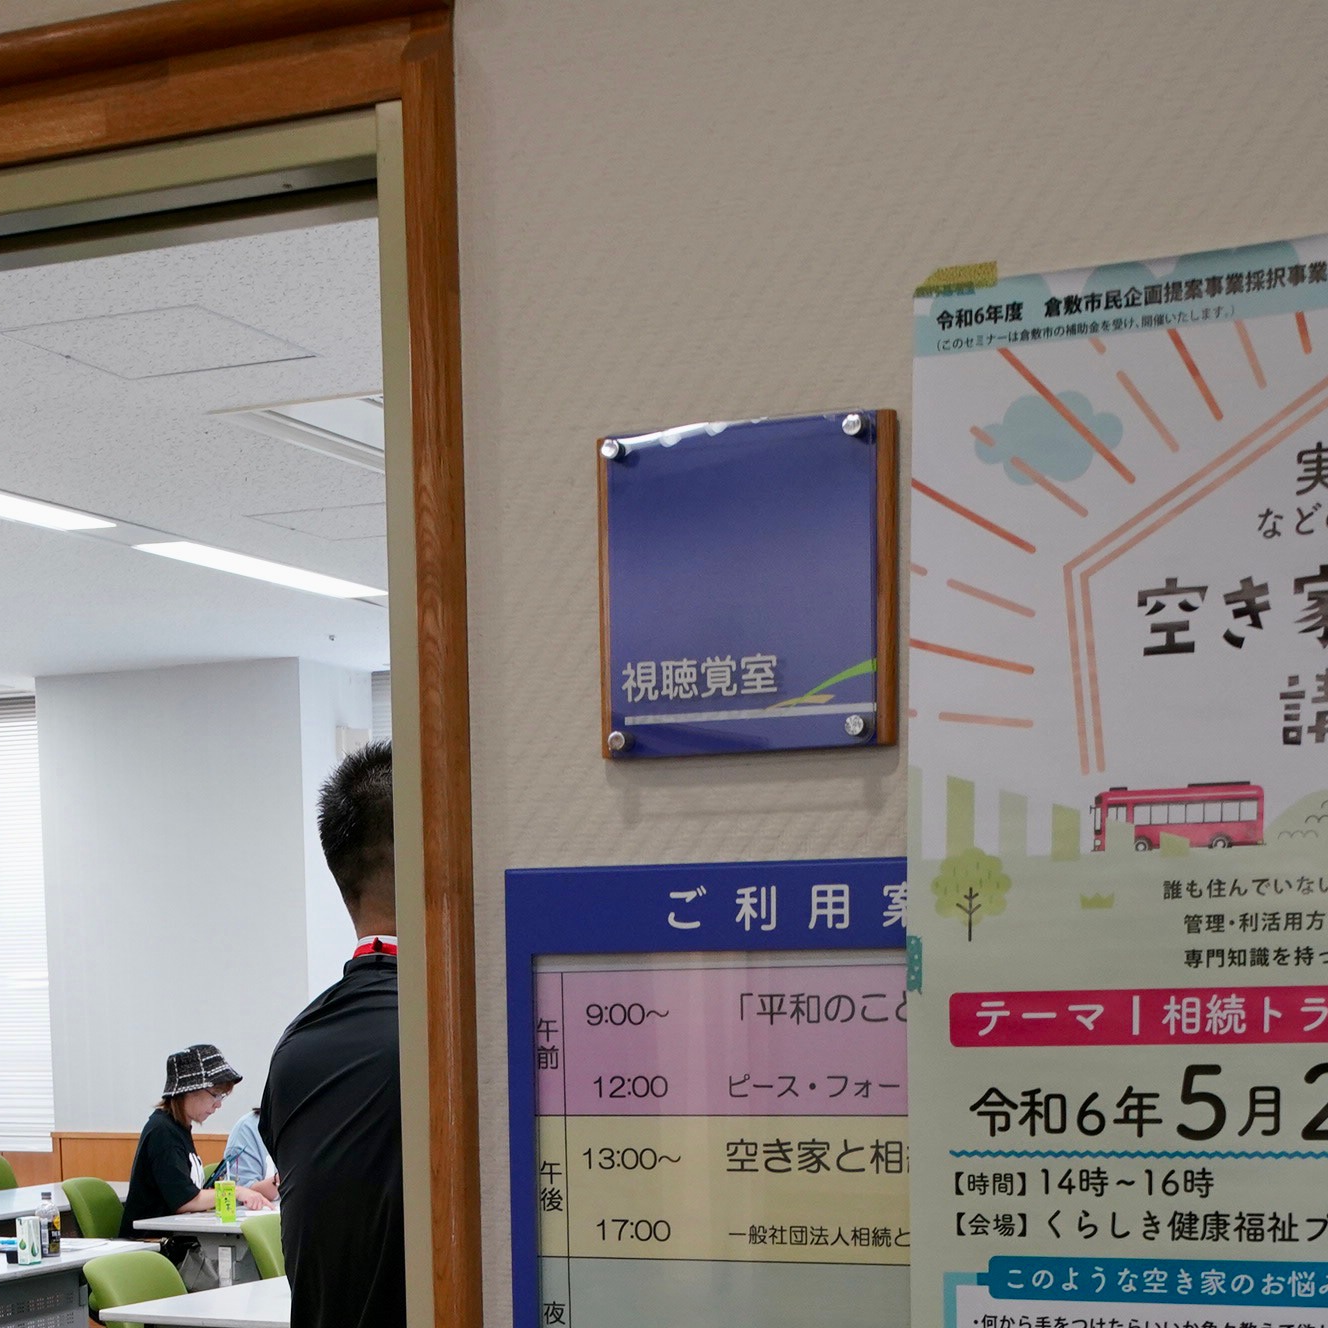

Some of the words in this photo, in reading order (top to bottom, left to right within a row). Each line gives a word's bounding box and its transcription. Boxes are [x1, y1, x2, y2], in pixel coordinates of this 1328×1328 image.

[936, 301, 1024, 332] 令和6年度
[1044, 261, 1328, 318] 倉敷市民企画提案事業採択事業
[621, 653, 778, 703] 視聴覚室
[975, 999, 1105, 1037] テーマ
[536, 1017, 560, 1070] 午前
[593, 1075, 669, 1099] 12:00
[726, 1137, 911, 1175] 空き家と相
[539, 1161, 564, 1213] 午後
[595, 1218, 672, 1243] 17:00
[728, 1223, 911, 1249] 一般社団法人相続と
